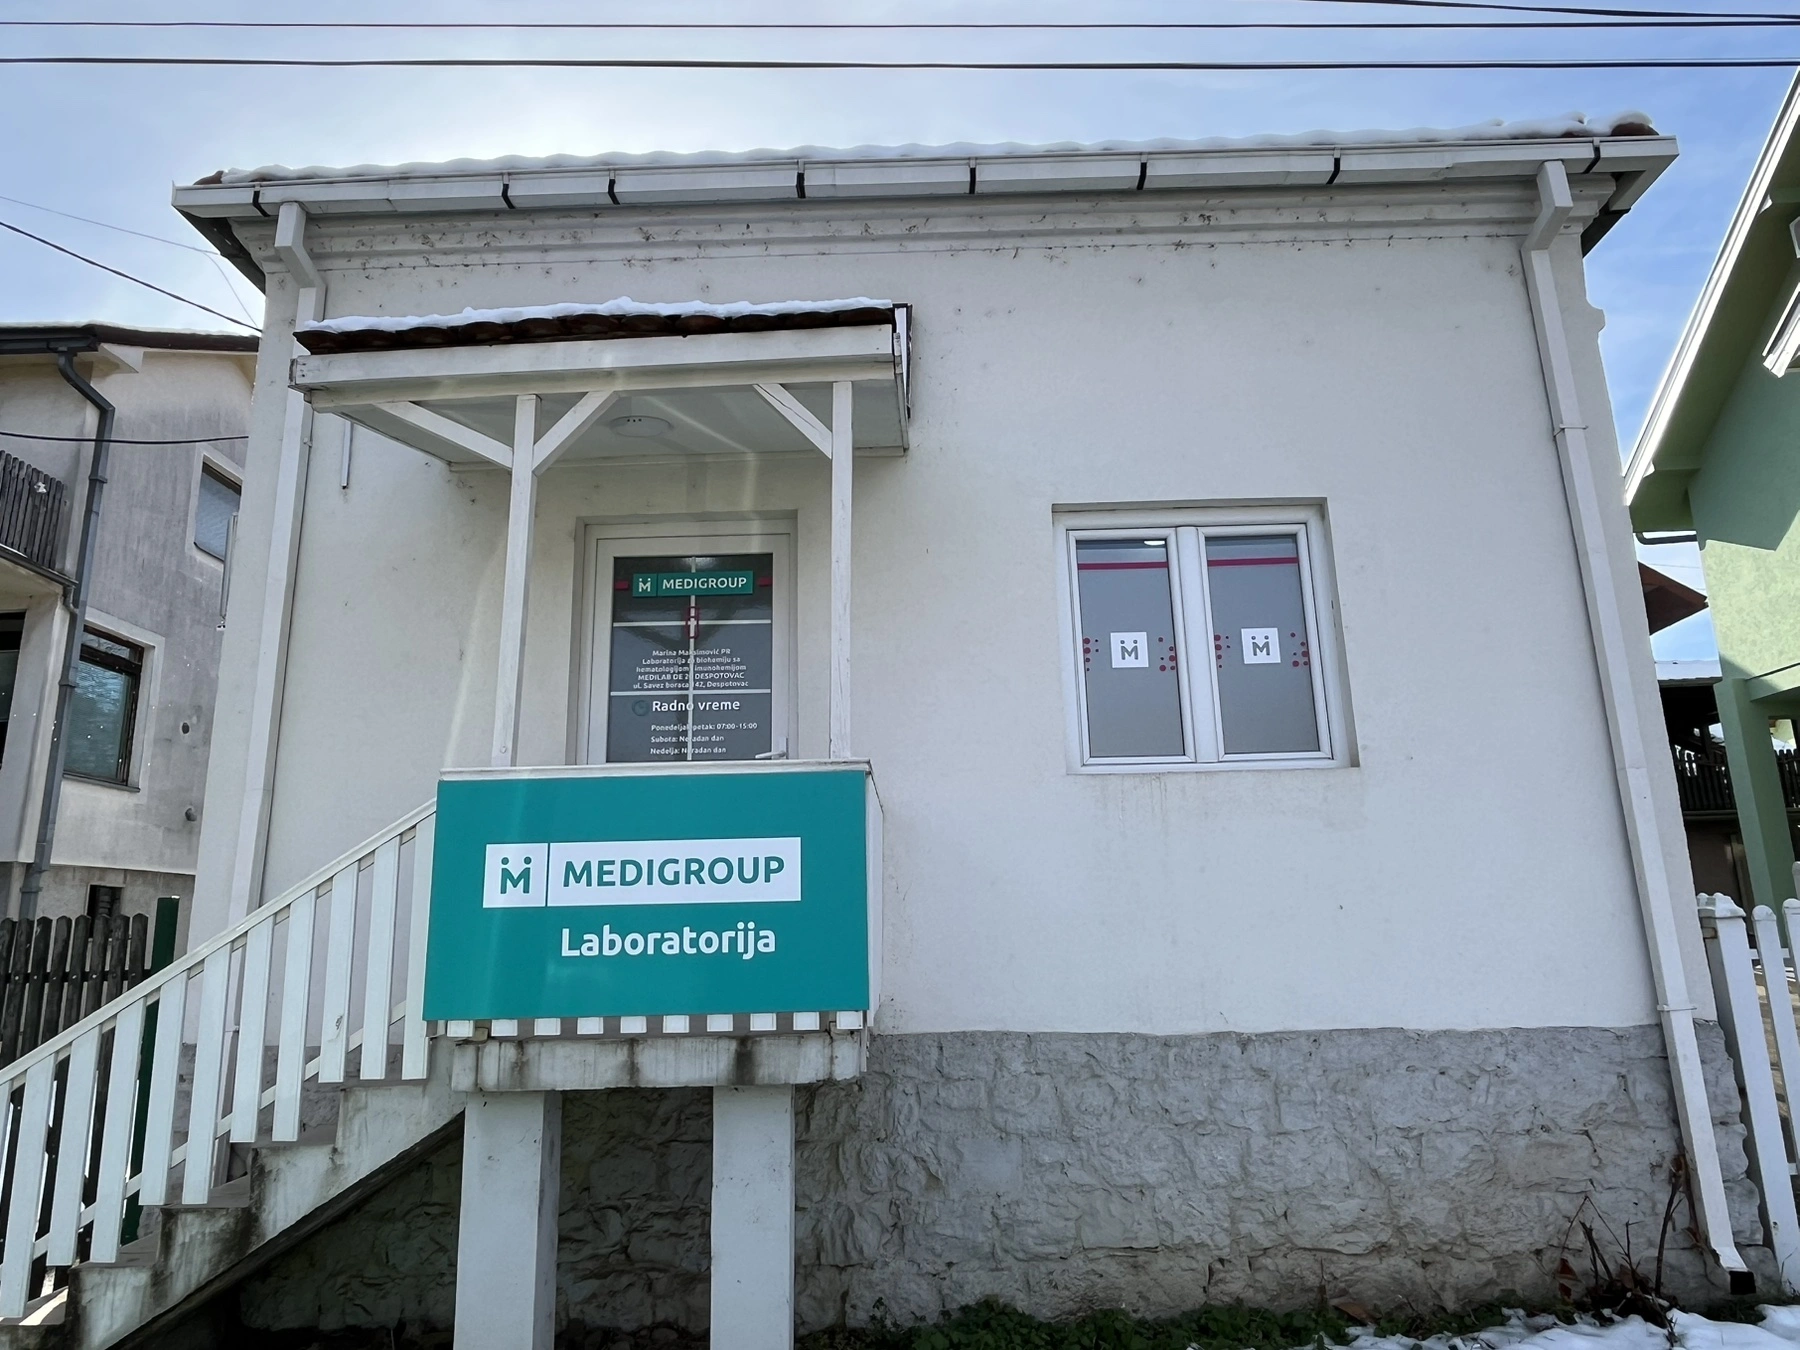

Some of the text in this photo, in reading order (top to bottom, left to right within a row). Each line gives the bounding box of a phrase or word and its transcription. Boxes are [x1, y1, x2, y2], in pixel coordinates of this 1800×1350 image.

[662, 577, 747, 589] MEDIGROUP
[694, 672, 745, 680] DESPOTOVAC
[706, 680, 749, 688] Despotovac
[652, 700, 741, 712] Radno vreme
[650, 735, 678, 743] Subota:
[650, 747, 680, 755] Nedelja:
[563, 856, 785, 888] MEDIGROUP
[561, 921, 776, 960] Laboratorija
